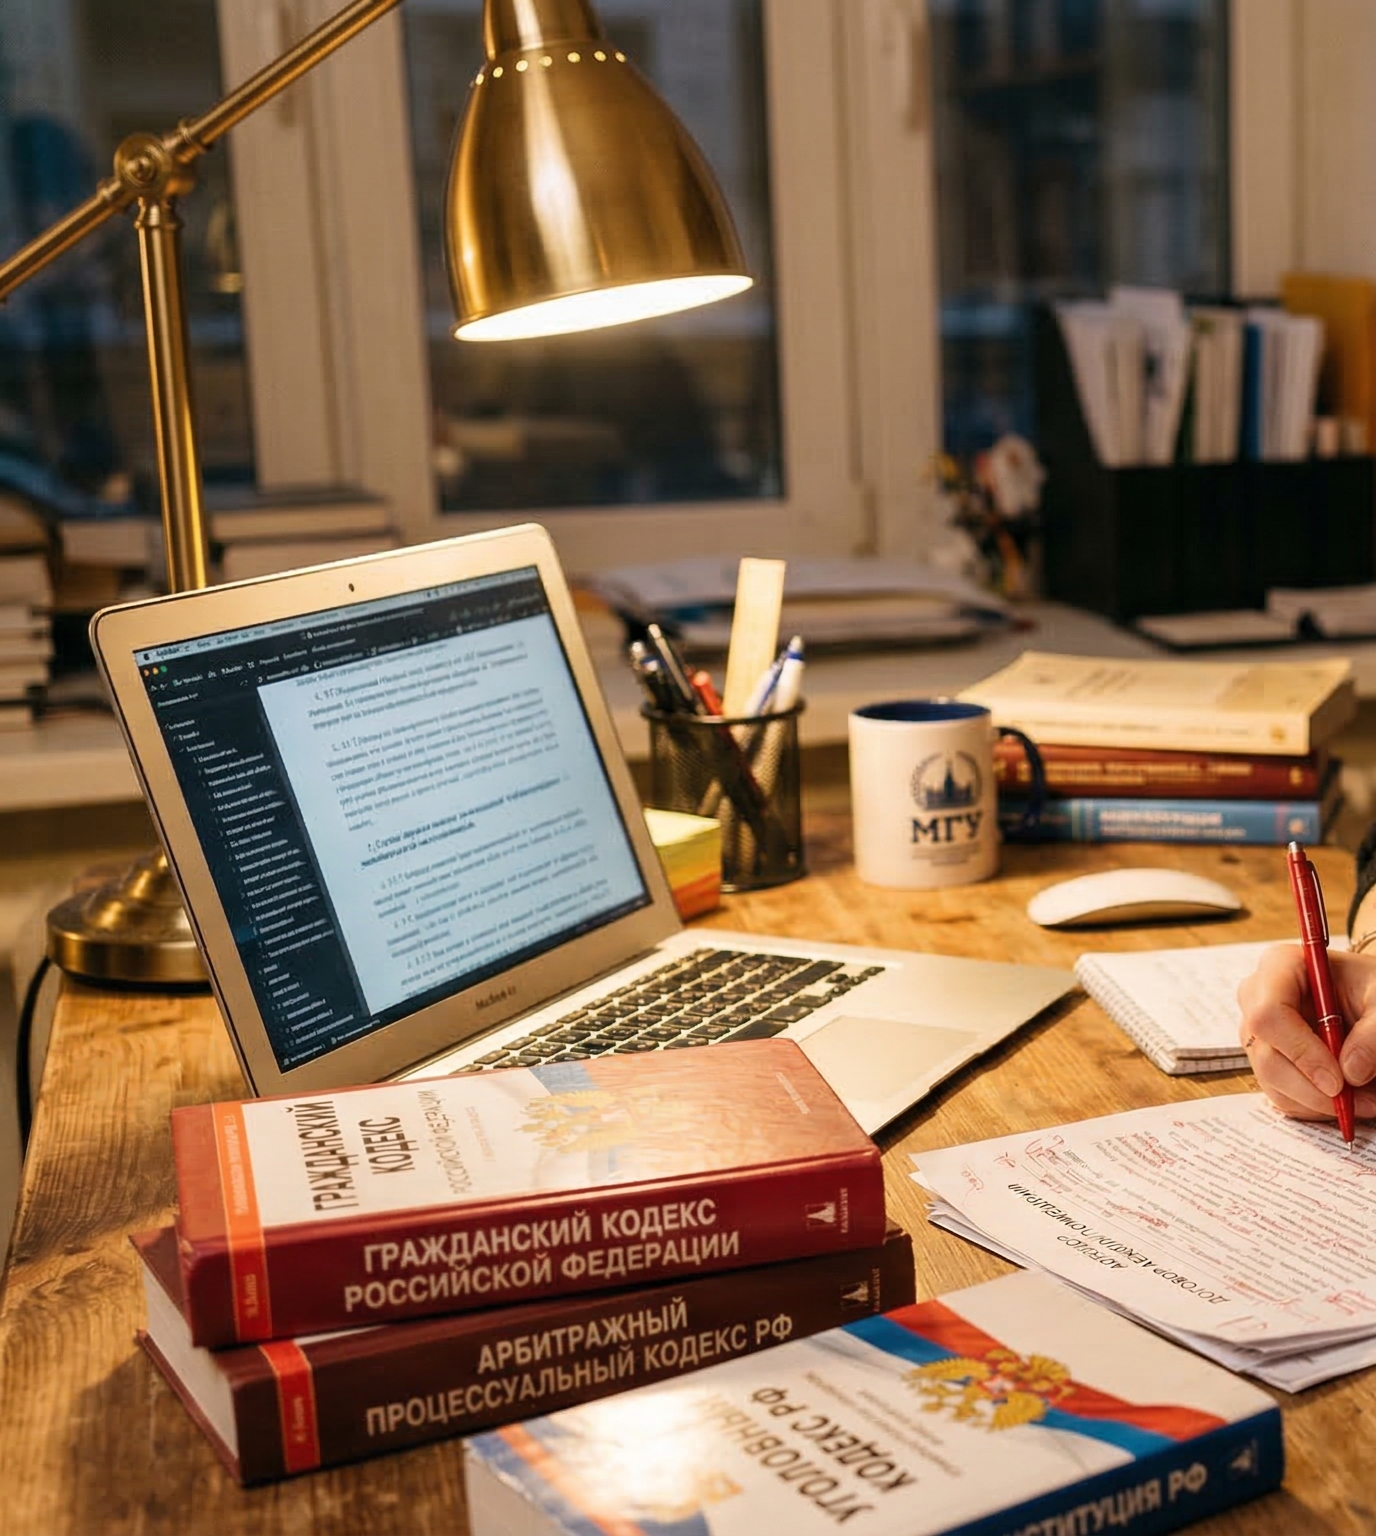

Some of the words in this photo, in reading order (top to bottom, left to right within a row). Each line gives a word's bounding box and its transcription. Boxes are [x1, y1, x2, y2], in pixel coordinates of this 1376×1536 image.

[911, 809, 983, 843] МГУ
[285, 1100, 360, 1211] ГРАЖДАНСКИЙ
[358, 1116, 420, 1175] КОДЕКС
[344, 1251, 552, 1312] РОССИЙСКОЙ
[561, 1231, 740, 1280] ФЕДЕРАЦИИ
[363, 1210, 592, 1273] ГРАЖДАНСКИЙ
[602, 1198, 717, 1240] КОДЕКС
[477, 1296, 688, 1375] АРБИТРАЖНЫЙ
[365, 1345, 636, 1437] ПРОЦЕССУАЛЬНЫЙ
[644, 1323, 748, 1373] КОДЕКС
[755, 1313, 793, 1345] РФ
[750, 1387, 808, 1418] РФ
[789, 1414, 918, 1494] КОДЕКС
[1002, 1479, 1162, 1536] СТИТУЦИЯ
[1168, 1462, 1209, 1502] РФ
